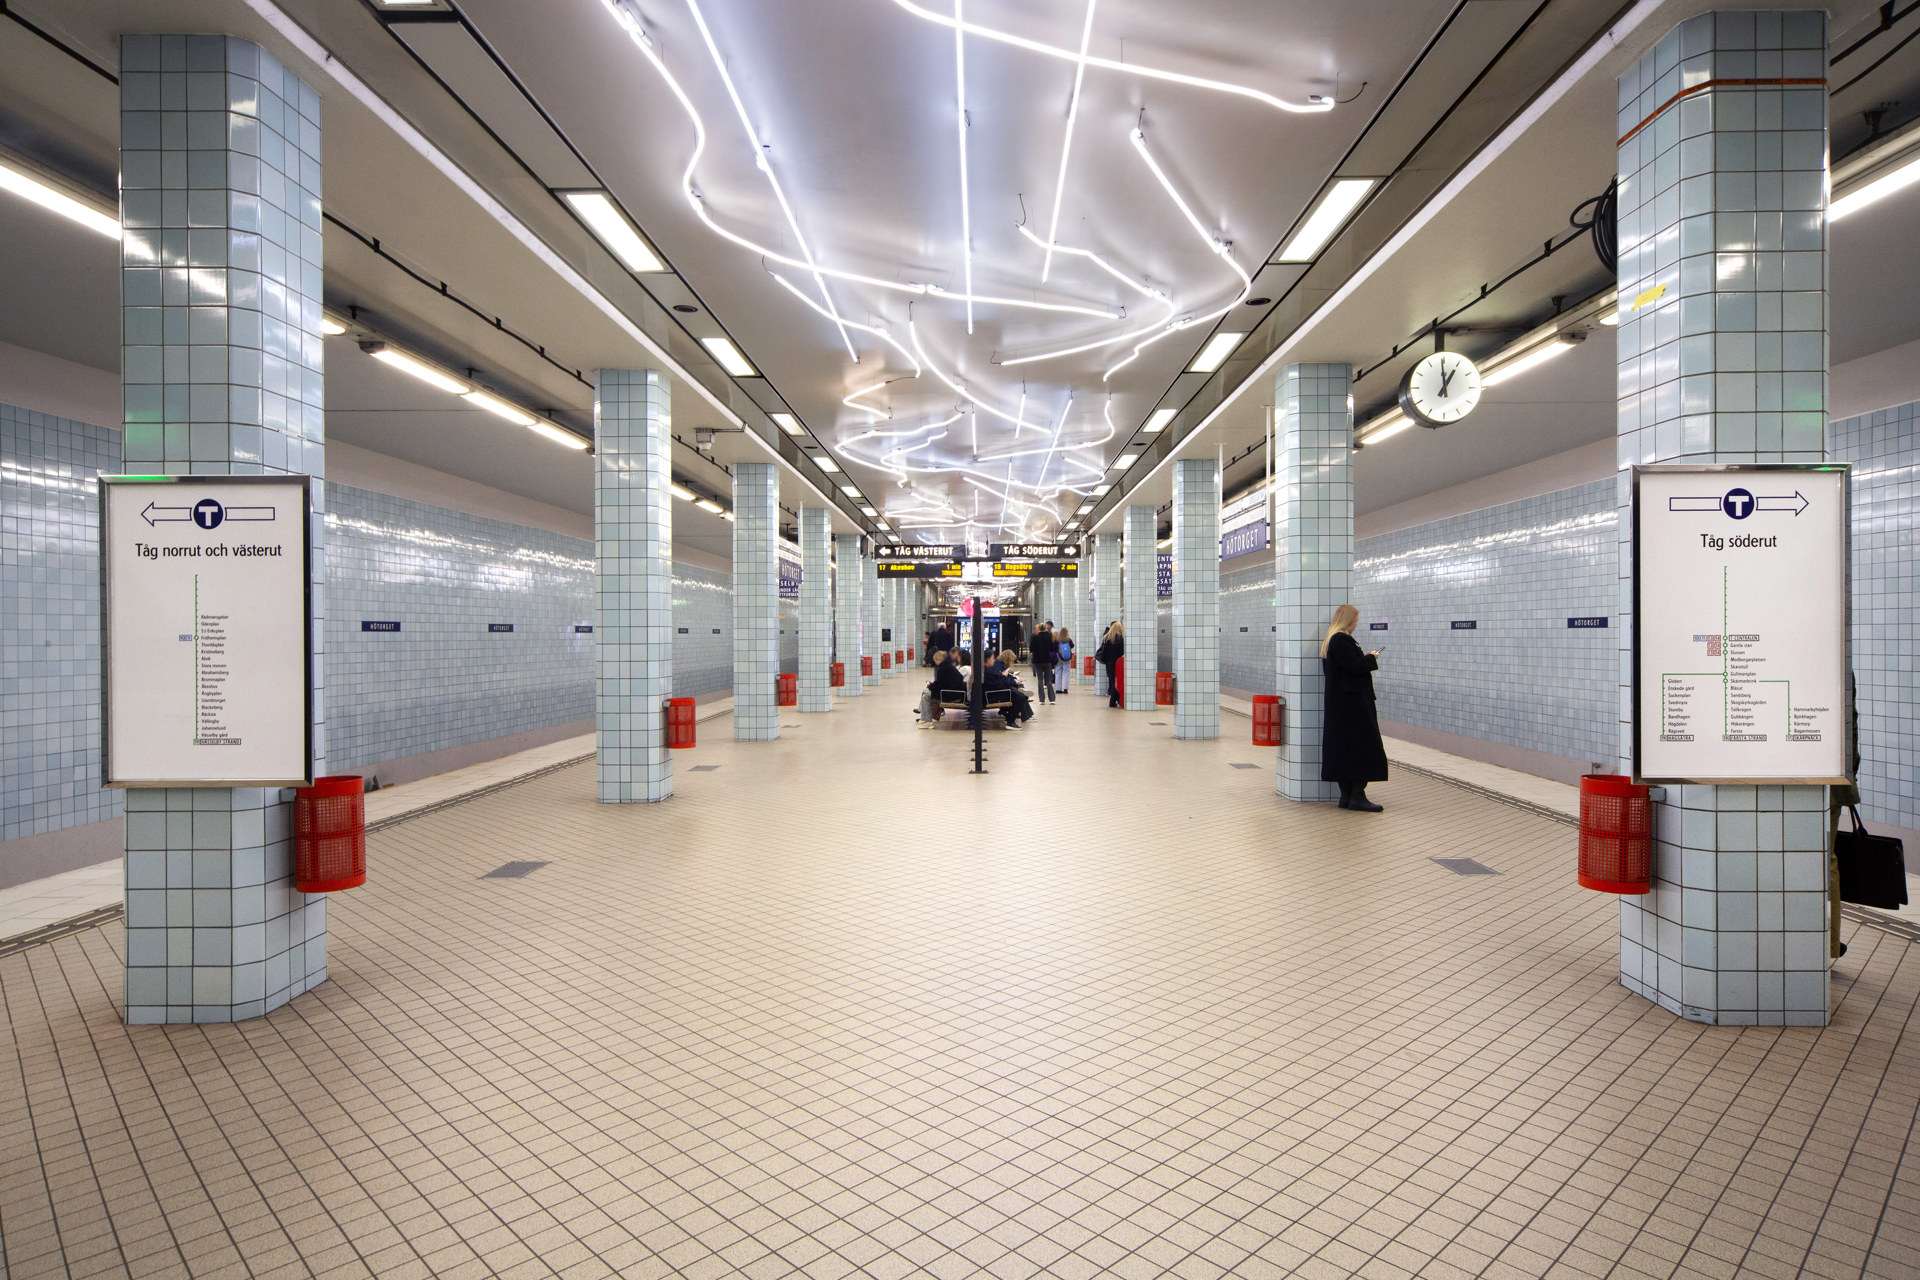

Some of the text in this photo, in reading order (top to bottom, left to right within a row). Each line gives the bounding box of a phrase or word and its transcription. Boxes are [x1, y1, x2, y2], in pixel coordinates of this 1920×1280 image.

[1003, 545, 1058, 555] TÅG SÖDERUT
[1226, 528, 1258, 555] HÖTORGET
[1701, 533, 1777, 551] Tåg söderut
[135, 543, 282, 560] Tåg norrut och västerut
[895, 546, 953, 555] TÅG VÄSTERUT
